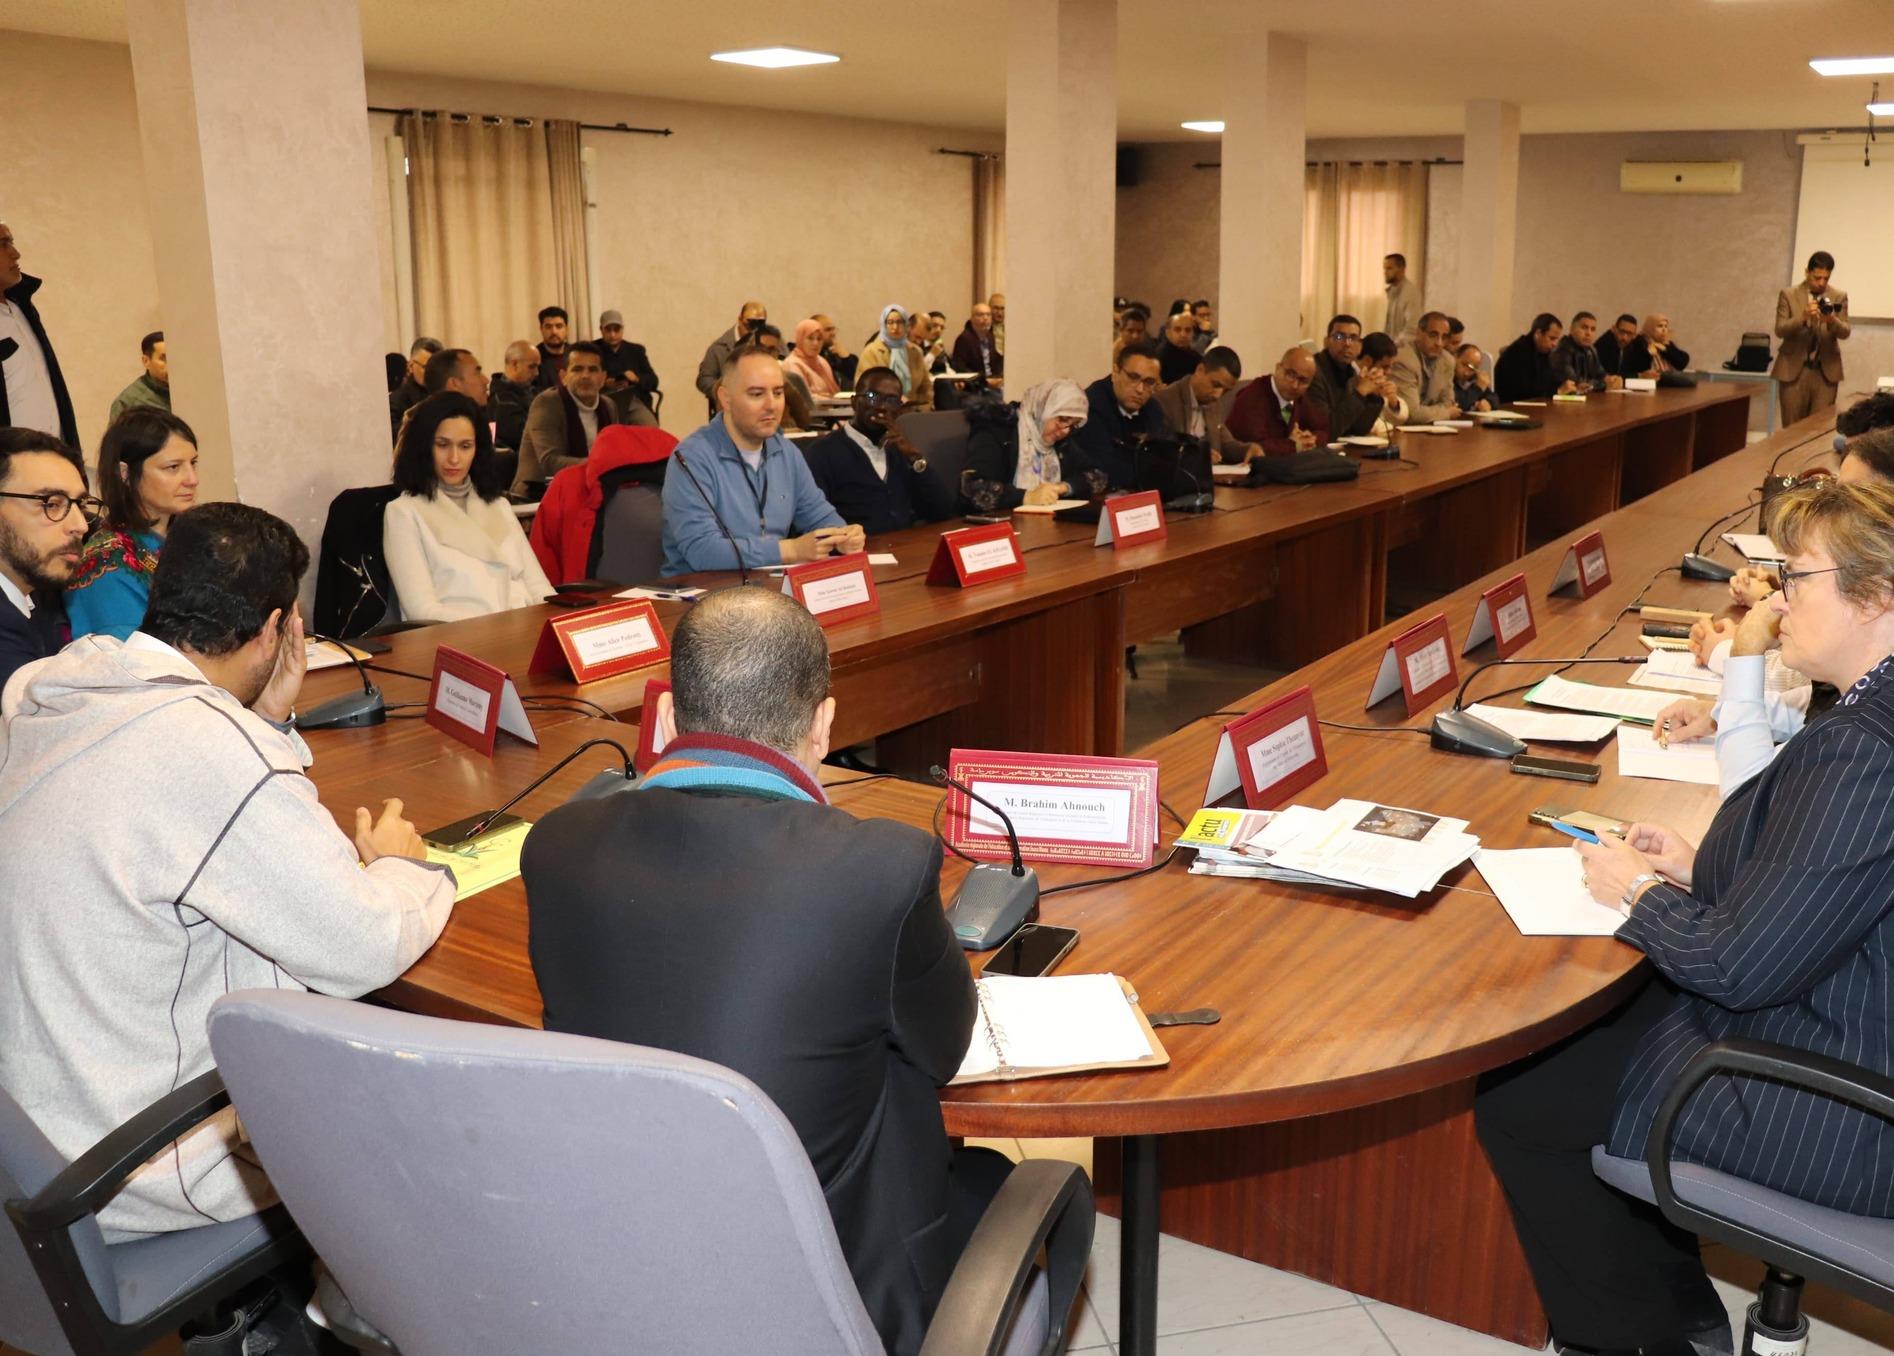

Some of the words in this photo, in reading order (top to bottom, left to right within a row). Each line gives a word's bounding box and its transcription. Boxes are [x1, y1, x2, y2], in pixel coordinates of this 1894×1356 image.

[1004, 797, 1018, 808] M.
[1020, 798, 1058, 810] Brahim
[1060, 800, 1106, 813] Ahnouch
